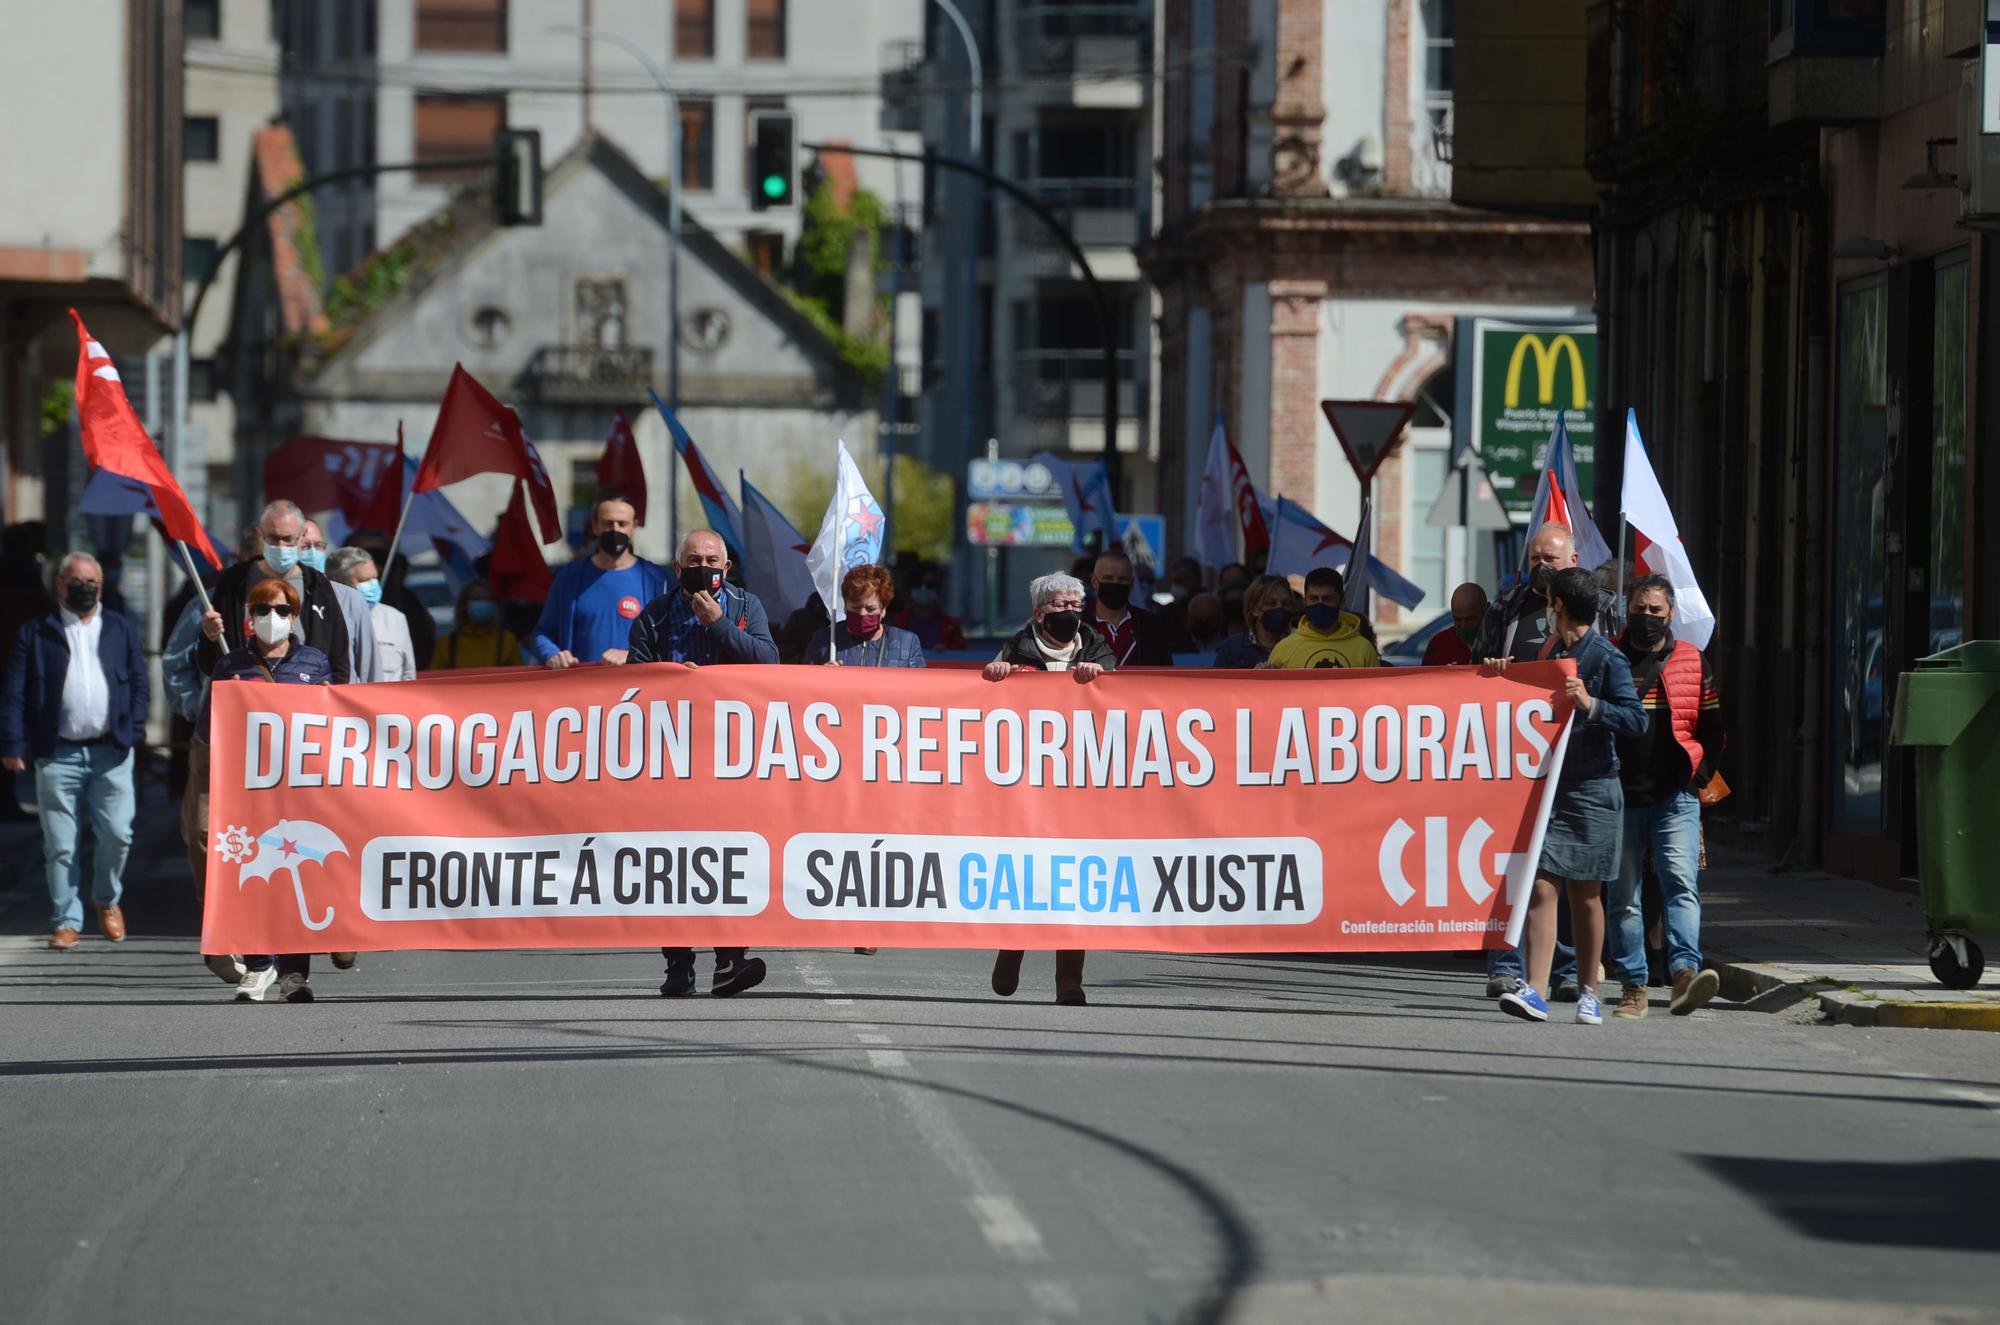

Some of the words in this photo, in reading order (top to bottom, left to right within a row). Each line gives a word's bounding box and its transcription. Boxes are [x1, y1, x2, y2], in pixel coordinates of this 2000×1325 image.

[244, 688, 691, 790] DERROGACIÓN
[713, 699, 842, 781] DAS
[861, 704, 1216, 787] REFORMAS
[1235, 699, 1555, 786] LABORAIS
[381, 849, 559, 909] FRONTE
[569, 837, 602, 904] Á
[613, 846, 749, 905] CRISE
[806, 839, 947, 909] SAÍDA
[959, 852, 1141, 913] GALEGA
[1152, 853, 1305, 913] XUSTA
[1378, 816, 1528, 907] CIG
[1341, 919, 1434, 934] Confederación
